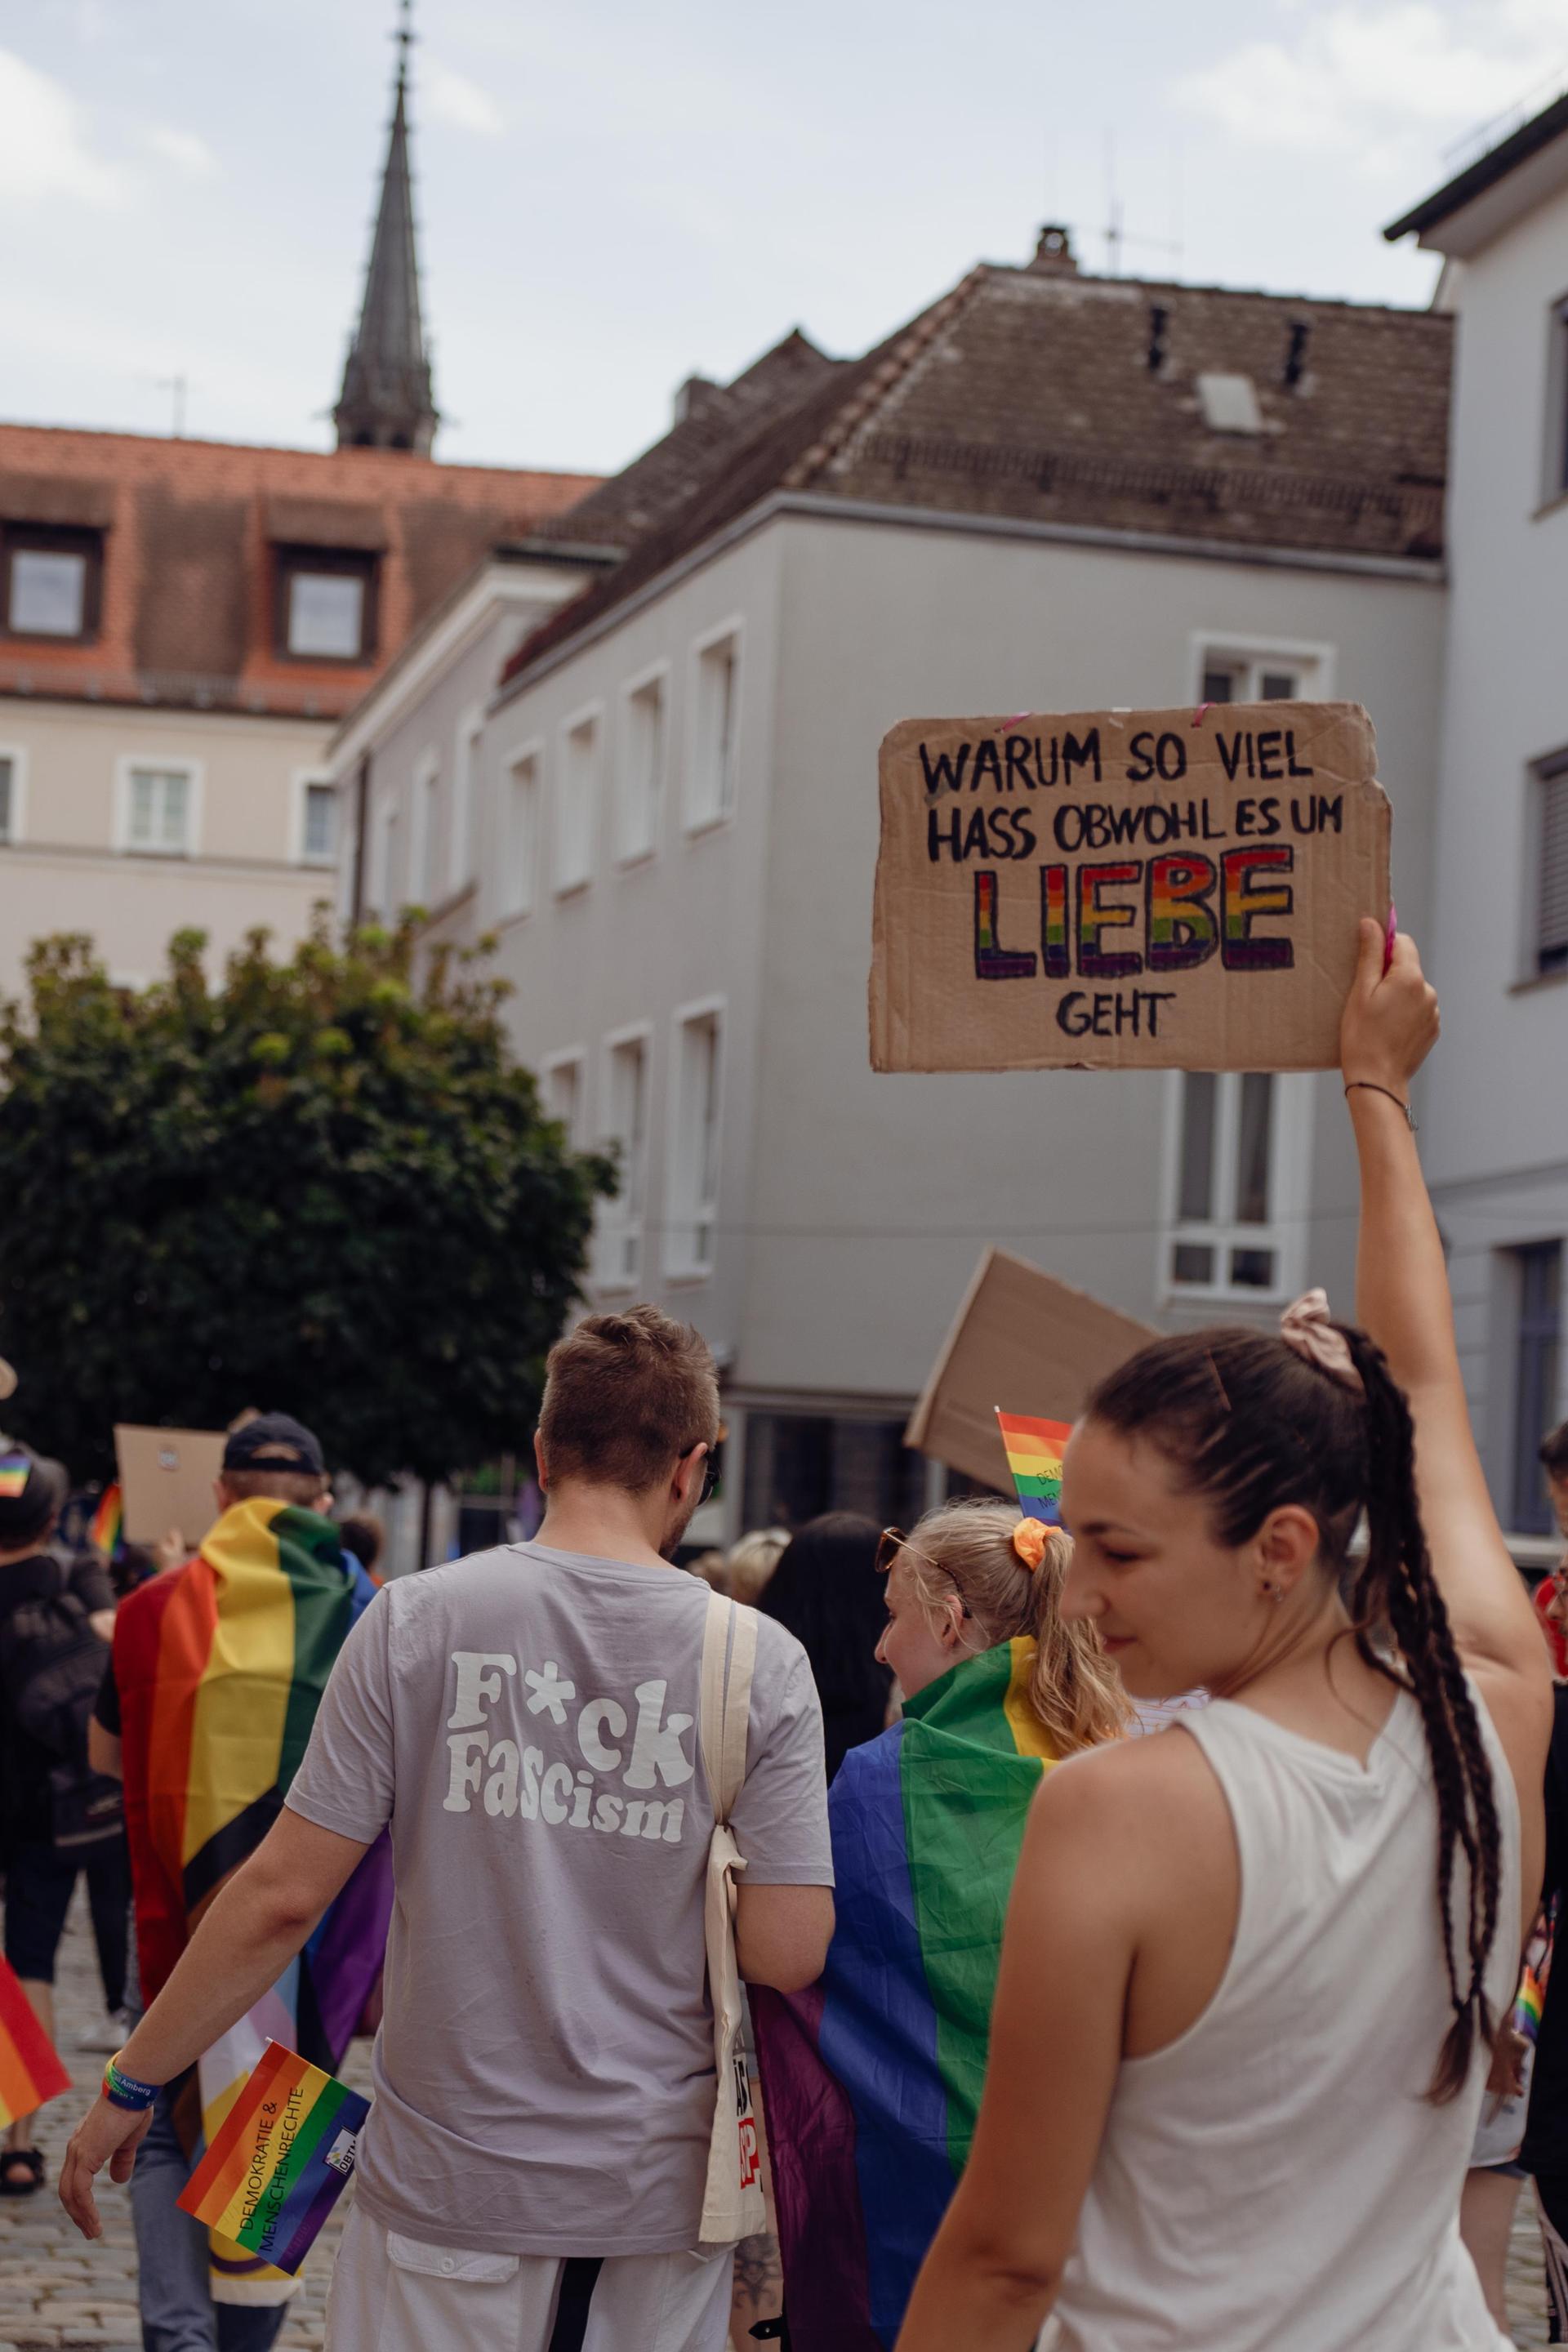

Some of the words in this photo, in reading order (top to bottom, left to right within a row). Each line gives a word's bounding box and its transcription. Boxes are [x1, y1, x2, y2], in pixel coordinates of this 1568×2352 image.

[920, 728, 1102, 794] WARUM
[1126, 732, 1186, 781] SO
[1215, 730, 1314, 781] VIEL
[927, 806, 1036, 862] HASS
[1054, 798, 1227, 852] OBWOHL
[1236, 798, 1281, 836] ES
[1290, 795, 1343, 834] UM
[974, 844, 1294, 980] LIEBE
[1056, 989, 1176, 1037] GEHT
[443, 1730, 685, 1843] Fascism
[121, 2078, 151, 2096] Amberg
[240, 2118, 274, 2230] DEMOKRATIE
[262, 2101, 277, 2114] &
[260, 2087, 304, 2252] MENSCHENRECHTE
